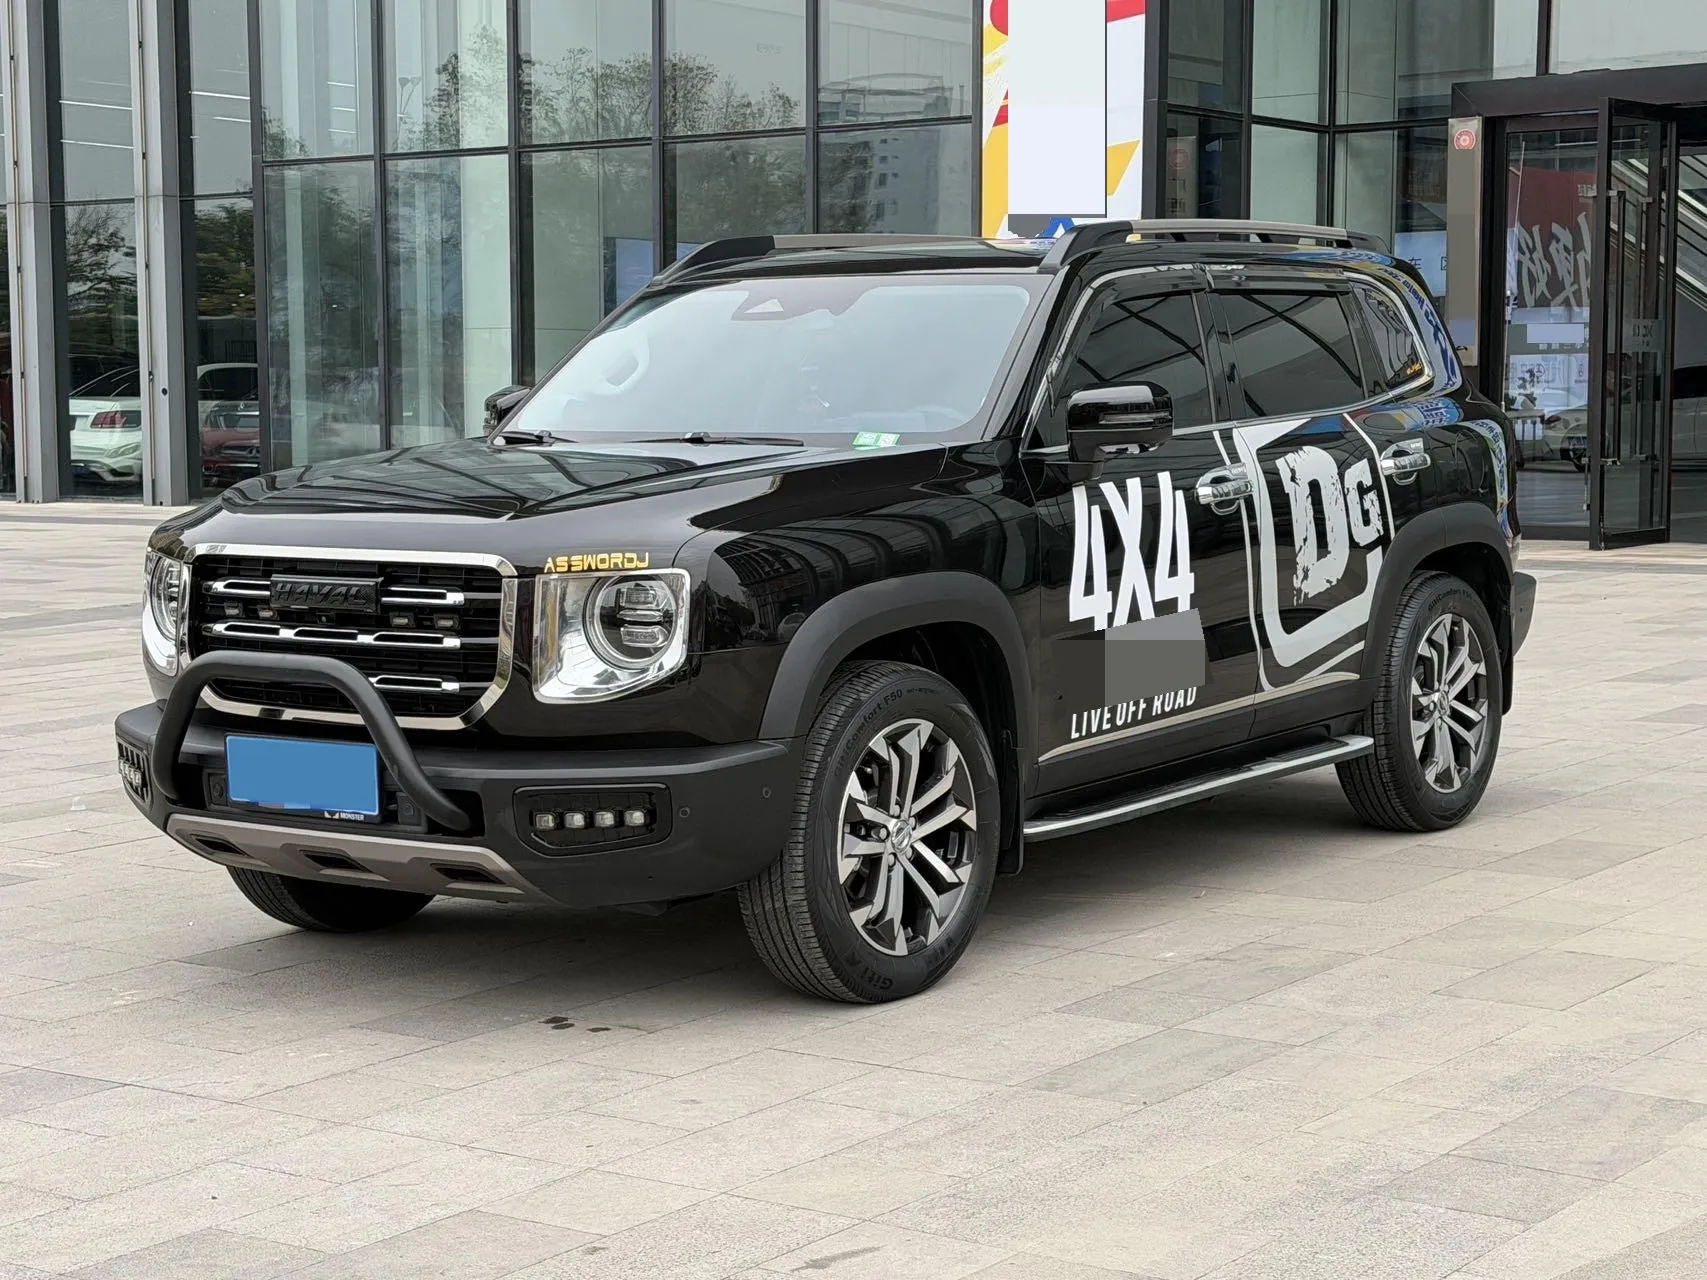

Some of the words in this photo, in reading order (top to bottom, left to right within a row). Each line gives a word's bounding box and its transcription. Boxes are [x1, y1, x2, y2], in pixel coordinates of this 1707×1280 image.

[1069, 471, 1195, 631] 4X4
[275, 583, 367, 605] HAVAL
[1071, 705, 1112, 739] LIVE
[340, 811, 365, 821] MONSTER
